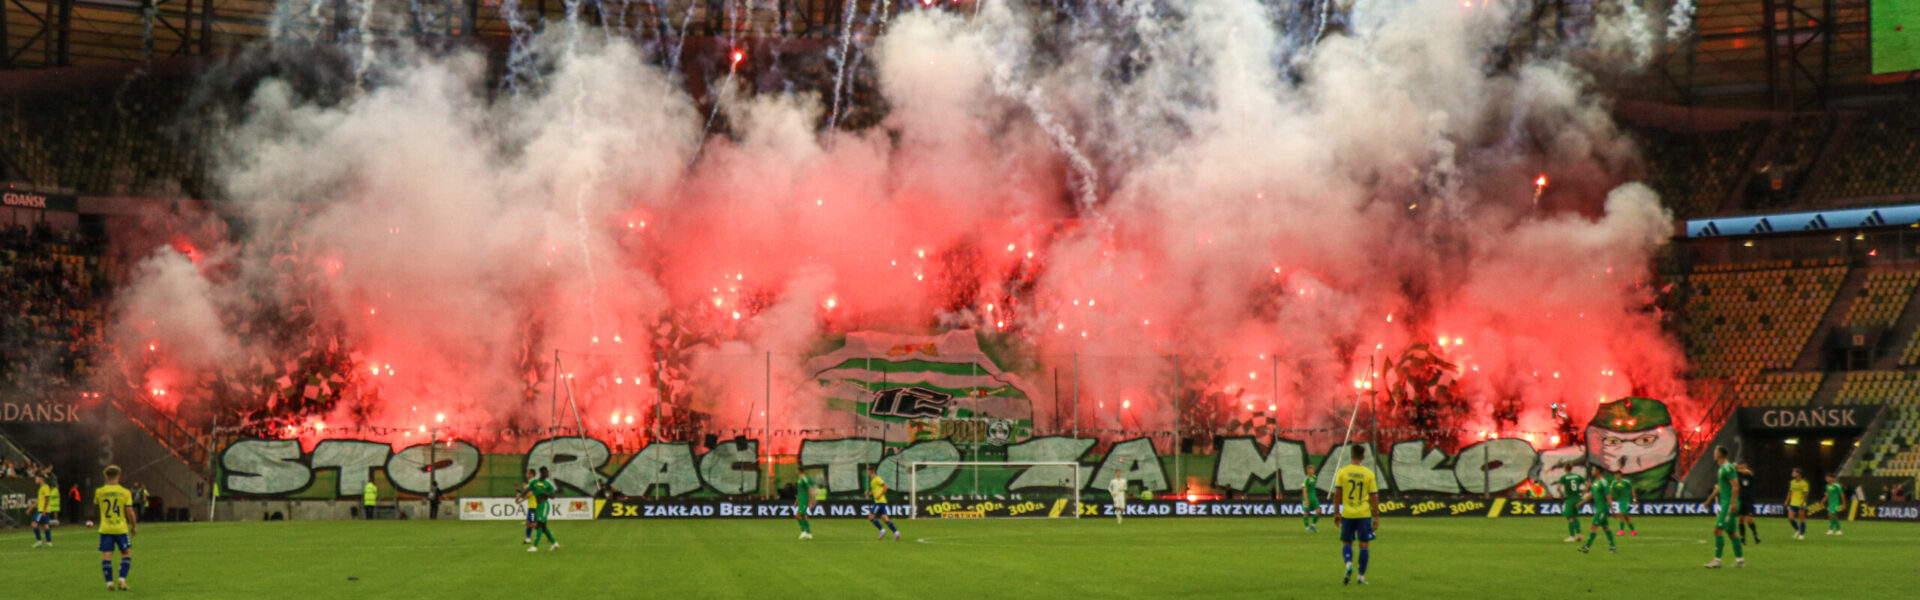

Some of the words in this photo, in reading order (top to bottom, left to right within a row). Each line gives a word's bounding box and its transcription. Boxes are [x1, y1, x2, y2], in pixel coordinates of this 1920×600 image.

[3, 193, 46, 208] GDAŃSK
[0, 400, 80, 422] DAŃSK
[1763, 406, 1856, 427] GDAŃSK
[220, 437, 482, 497] STO
[522, 434, 761, 500] RAC
[799, 436, 961, 496] TO
[1003, 434, 1172, 495] ZA
[1348, 480, 1363, 500] 21
[1570, 480, 1577, 492] 6
[103, 499, 120, 518] 24
[490, 503, 561, 517] GDAK
[611, 502, 639, 517] 3x
[643, 504, 714, 517] ZAKŁAD
[830, 505, 856, 516] NA
[1104, 504, 1171, 515] ZKŁAD
[1211, 504, 1276, 515] RYZYKA
[1378, 501, 1405, 513] 00zł
[1510, 501, 1536, 515] 3x
[1861, 503, 1876, 517] 3x
[1878, 507, 1918, 517] ZAKŁAD
